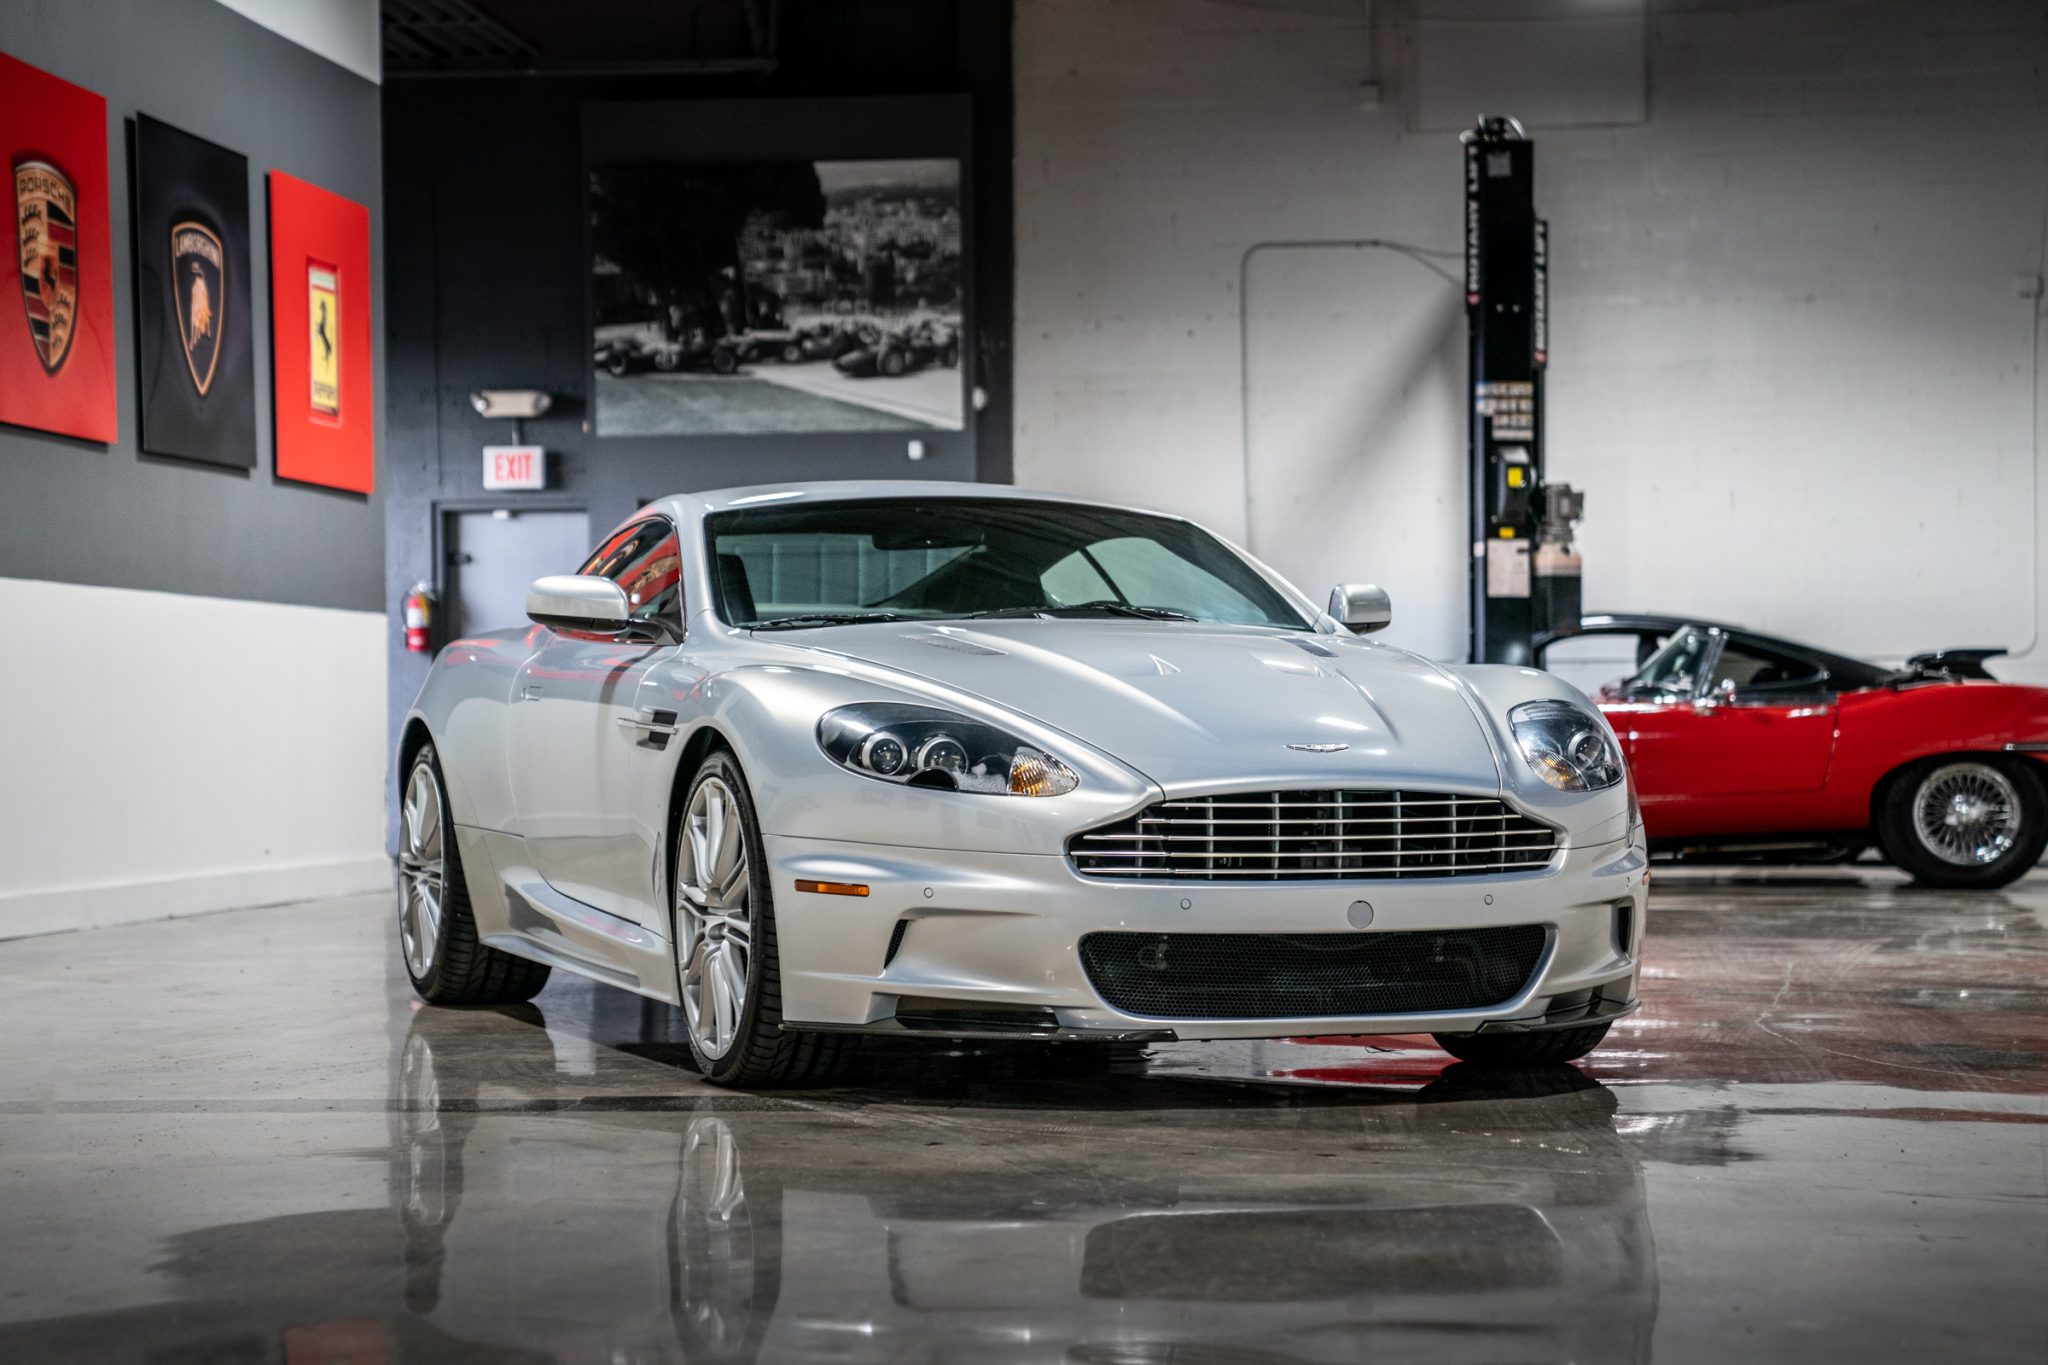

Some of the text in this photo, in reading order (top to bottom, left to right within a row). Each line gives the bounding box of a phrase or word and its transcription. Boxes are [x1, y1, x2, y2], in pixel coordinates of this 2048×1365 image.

[19, 177, 72, 213] PORSCHE
[1468, 146, 1480, 291] ROTARY LIFT
[1534, 222, 1546, 351] ROTARY LIFT
[495, 452, 533, 481] EXIT
